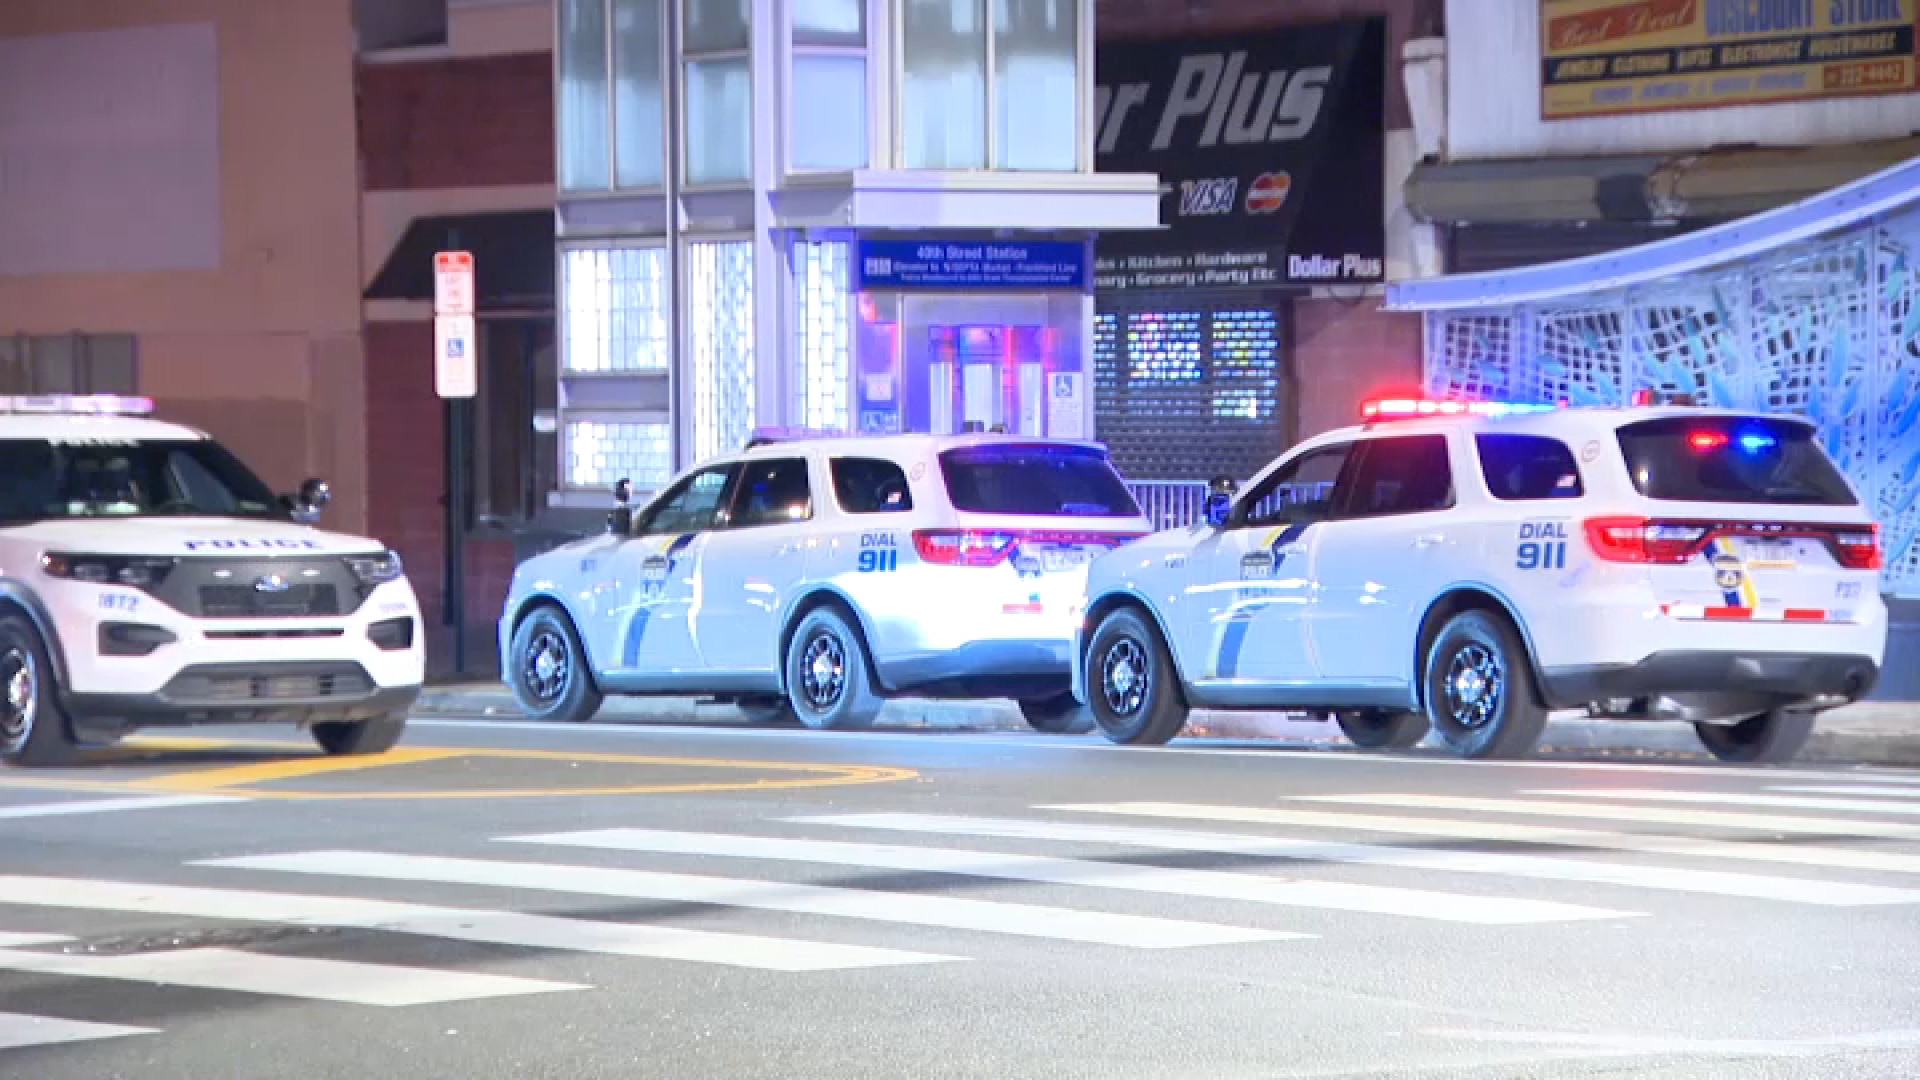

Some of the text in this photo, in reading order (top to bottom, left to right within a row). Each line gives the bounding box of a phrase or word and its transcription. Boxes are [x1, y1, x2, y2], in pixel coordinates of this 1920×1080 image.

[1151, 51, 1333, 150] Plus
[1178, 176, 1238, 216] VISA
[946, 245, 982, 260] Street
[985, 245, 1028, 260] Station
[1288, 254, 1382, 278] Dollar Plus
[860, 532, 897, 548] DIAL
[1519, 522, 1568, 539] DIAL
[183, 539, 326, 550] POLICE
[1516, 541, 1566, 570] 911
[857, 549, 898, 573] 911
